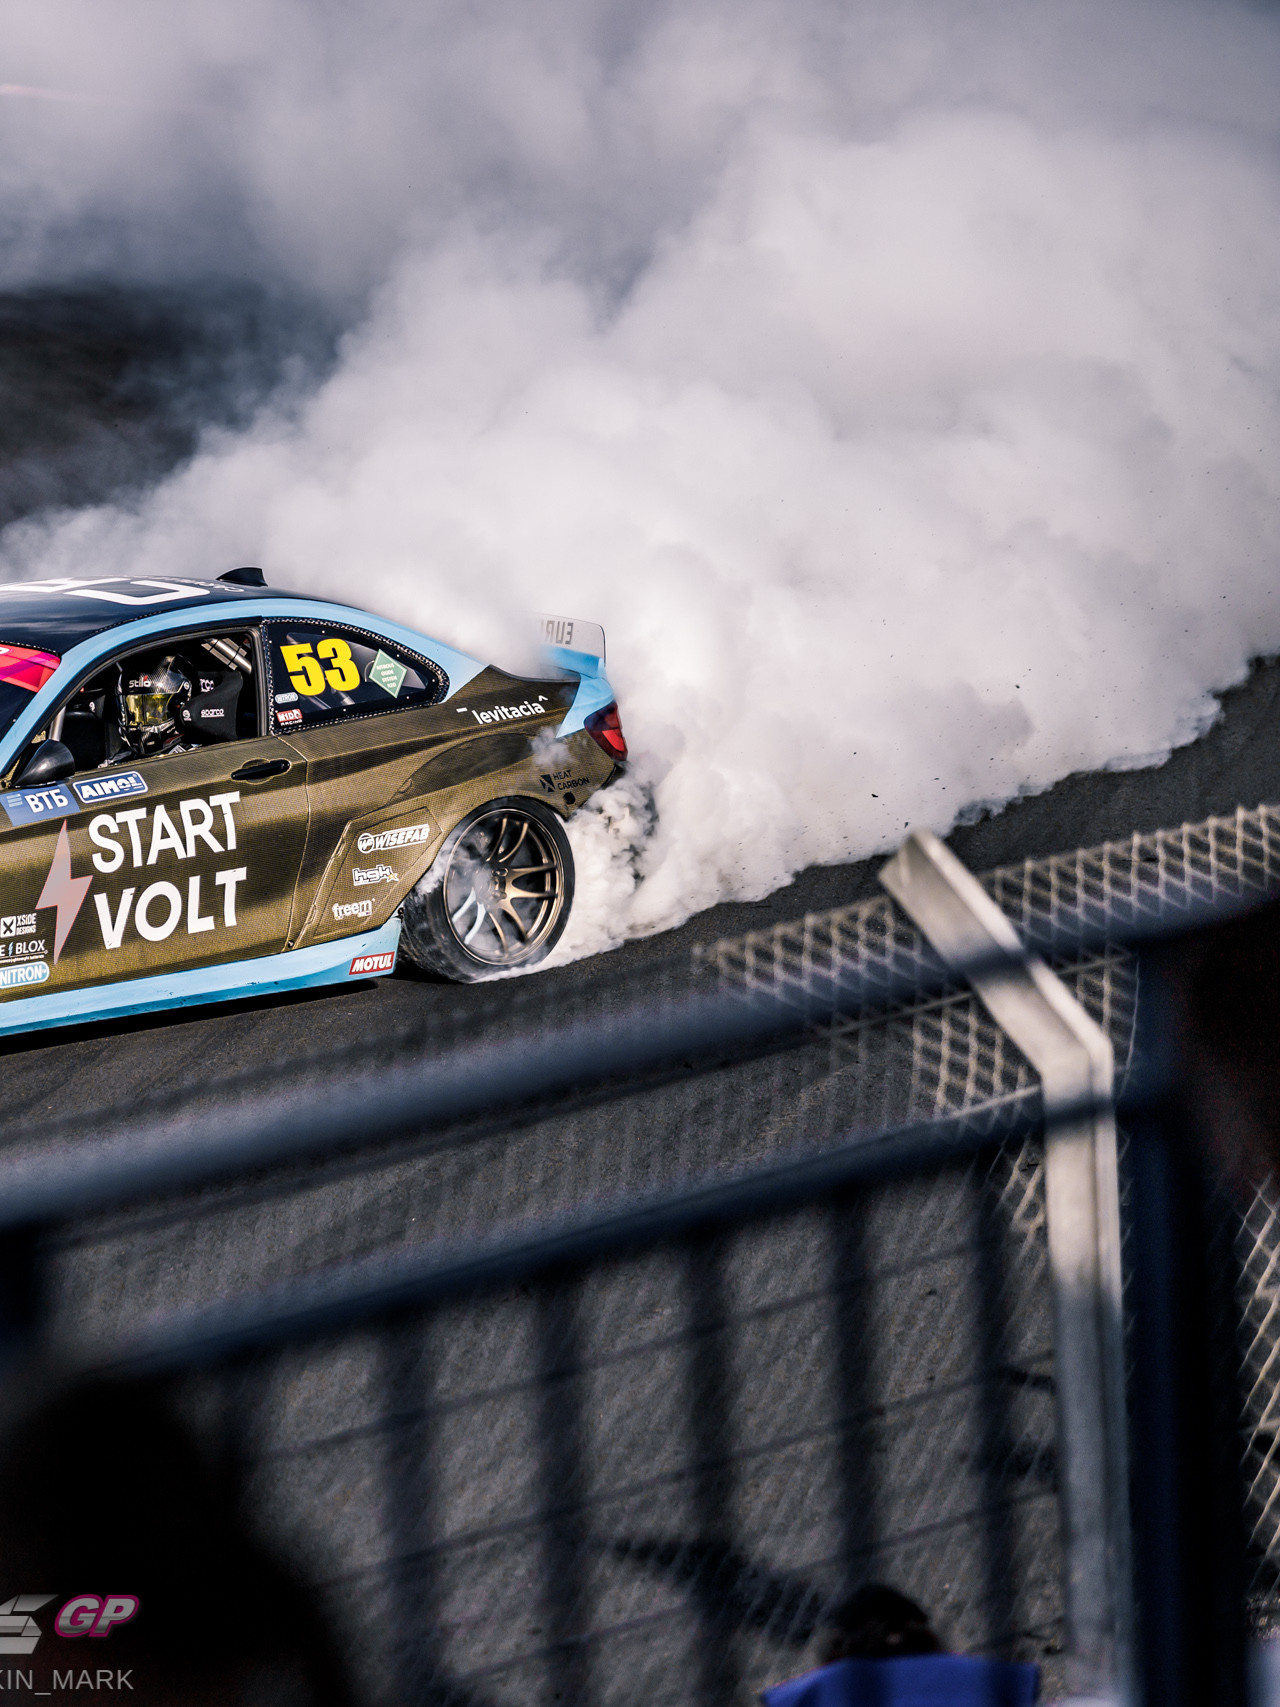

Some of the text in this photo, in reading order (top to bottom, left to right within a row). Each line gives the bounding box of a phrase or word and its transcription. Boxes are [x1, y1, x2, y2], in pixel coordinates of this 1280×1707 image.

[280, 638, 360, 696] 53
[201, 709, 224, 718] sparco
[553, 769, 572, 780] HEAT
[558, 776, 590, 790] CARBON
[81, 776, 142, 799] AIMOL
[25, 784, 69, 813] ВТБ
[88, 791, 241, 873] START
[375, 827, 429, 849] WISEFAB
[354, 865, 391, 883] hgk
[94, 866, 247, 950] VOLT
[332, 900, 372, 920] freem
[16, 939, 45, 955] BLOX
[351, 954, 392, 972] MOTUL
[0, 964, 42, 985] NITRON
